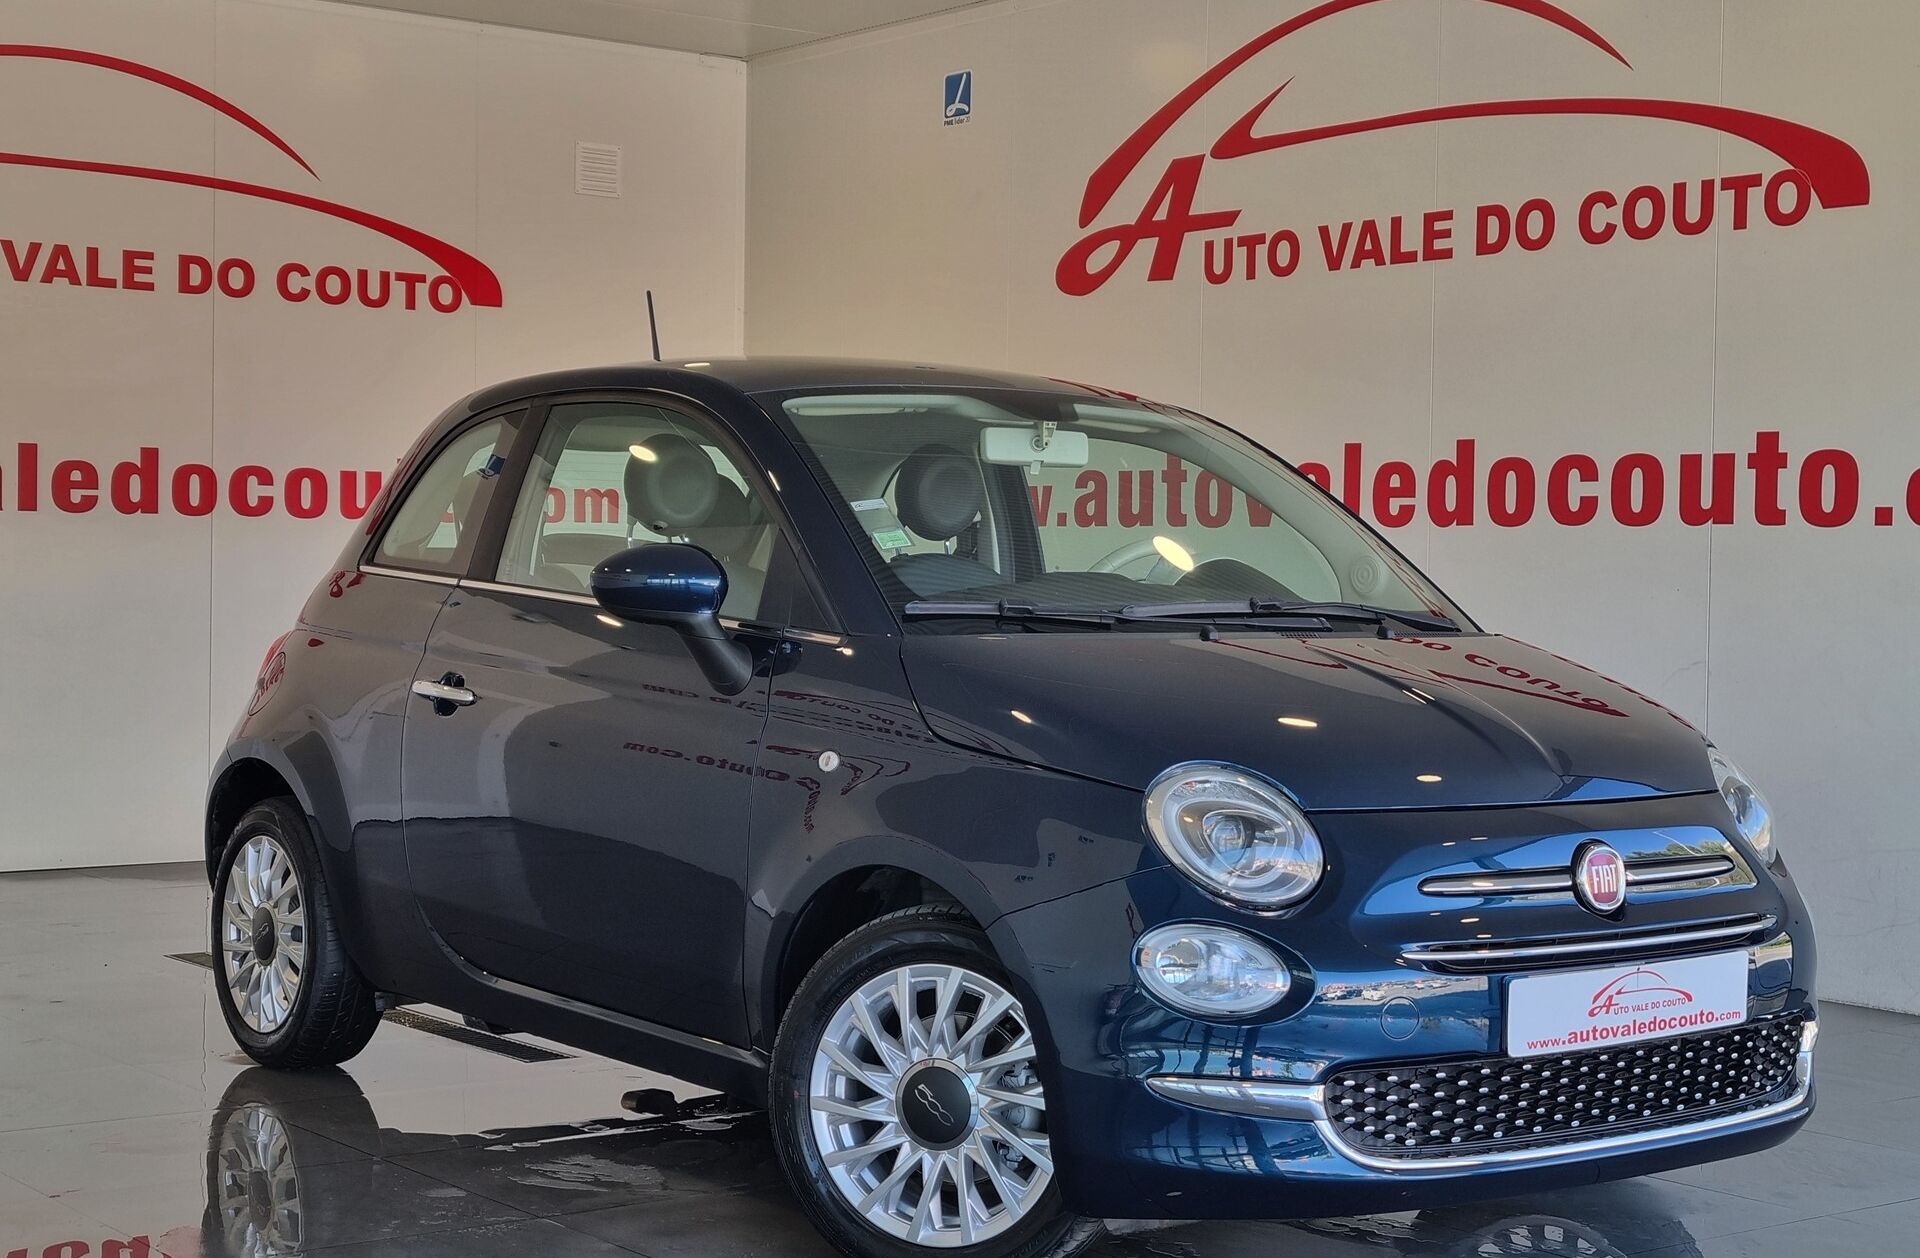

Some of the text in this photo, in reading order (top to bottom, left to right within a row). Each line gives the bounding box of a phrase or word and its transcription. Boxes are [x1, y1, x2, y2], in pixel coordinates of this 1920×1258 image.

[1317, 208, 1454, 273] VALE
[1475, 198, 1556, 257] DO
[1578, 168, 1812, 246] COUTO
[0, 239, 464, 314] VALE DO COUTO
[1591, 863, 1617, 894] FIAT
[1631, 1003, 1649, 1013] VALE
[1651, 1000, 1661, 1010] DO
[1662, 997, 1687, 1008] COUTO
[1527, 1008, 1741, 1050] www.autovaledocouto.com
